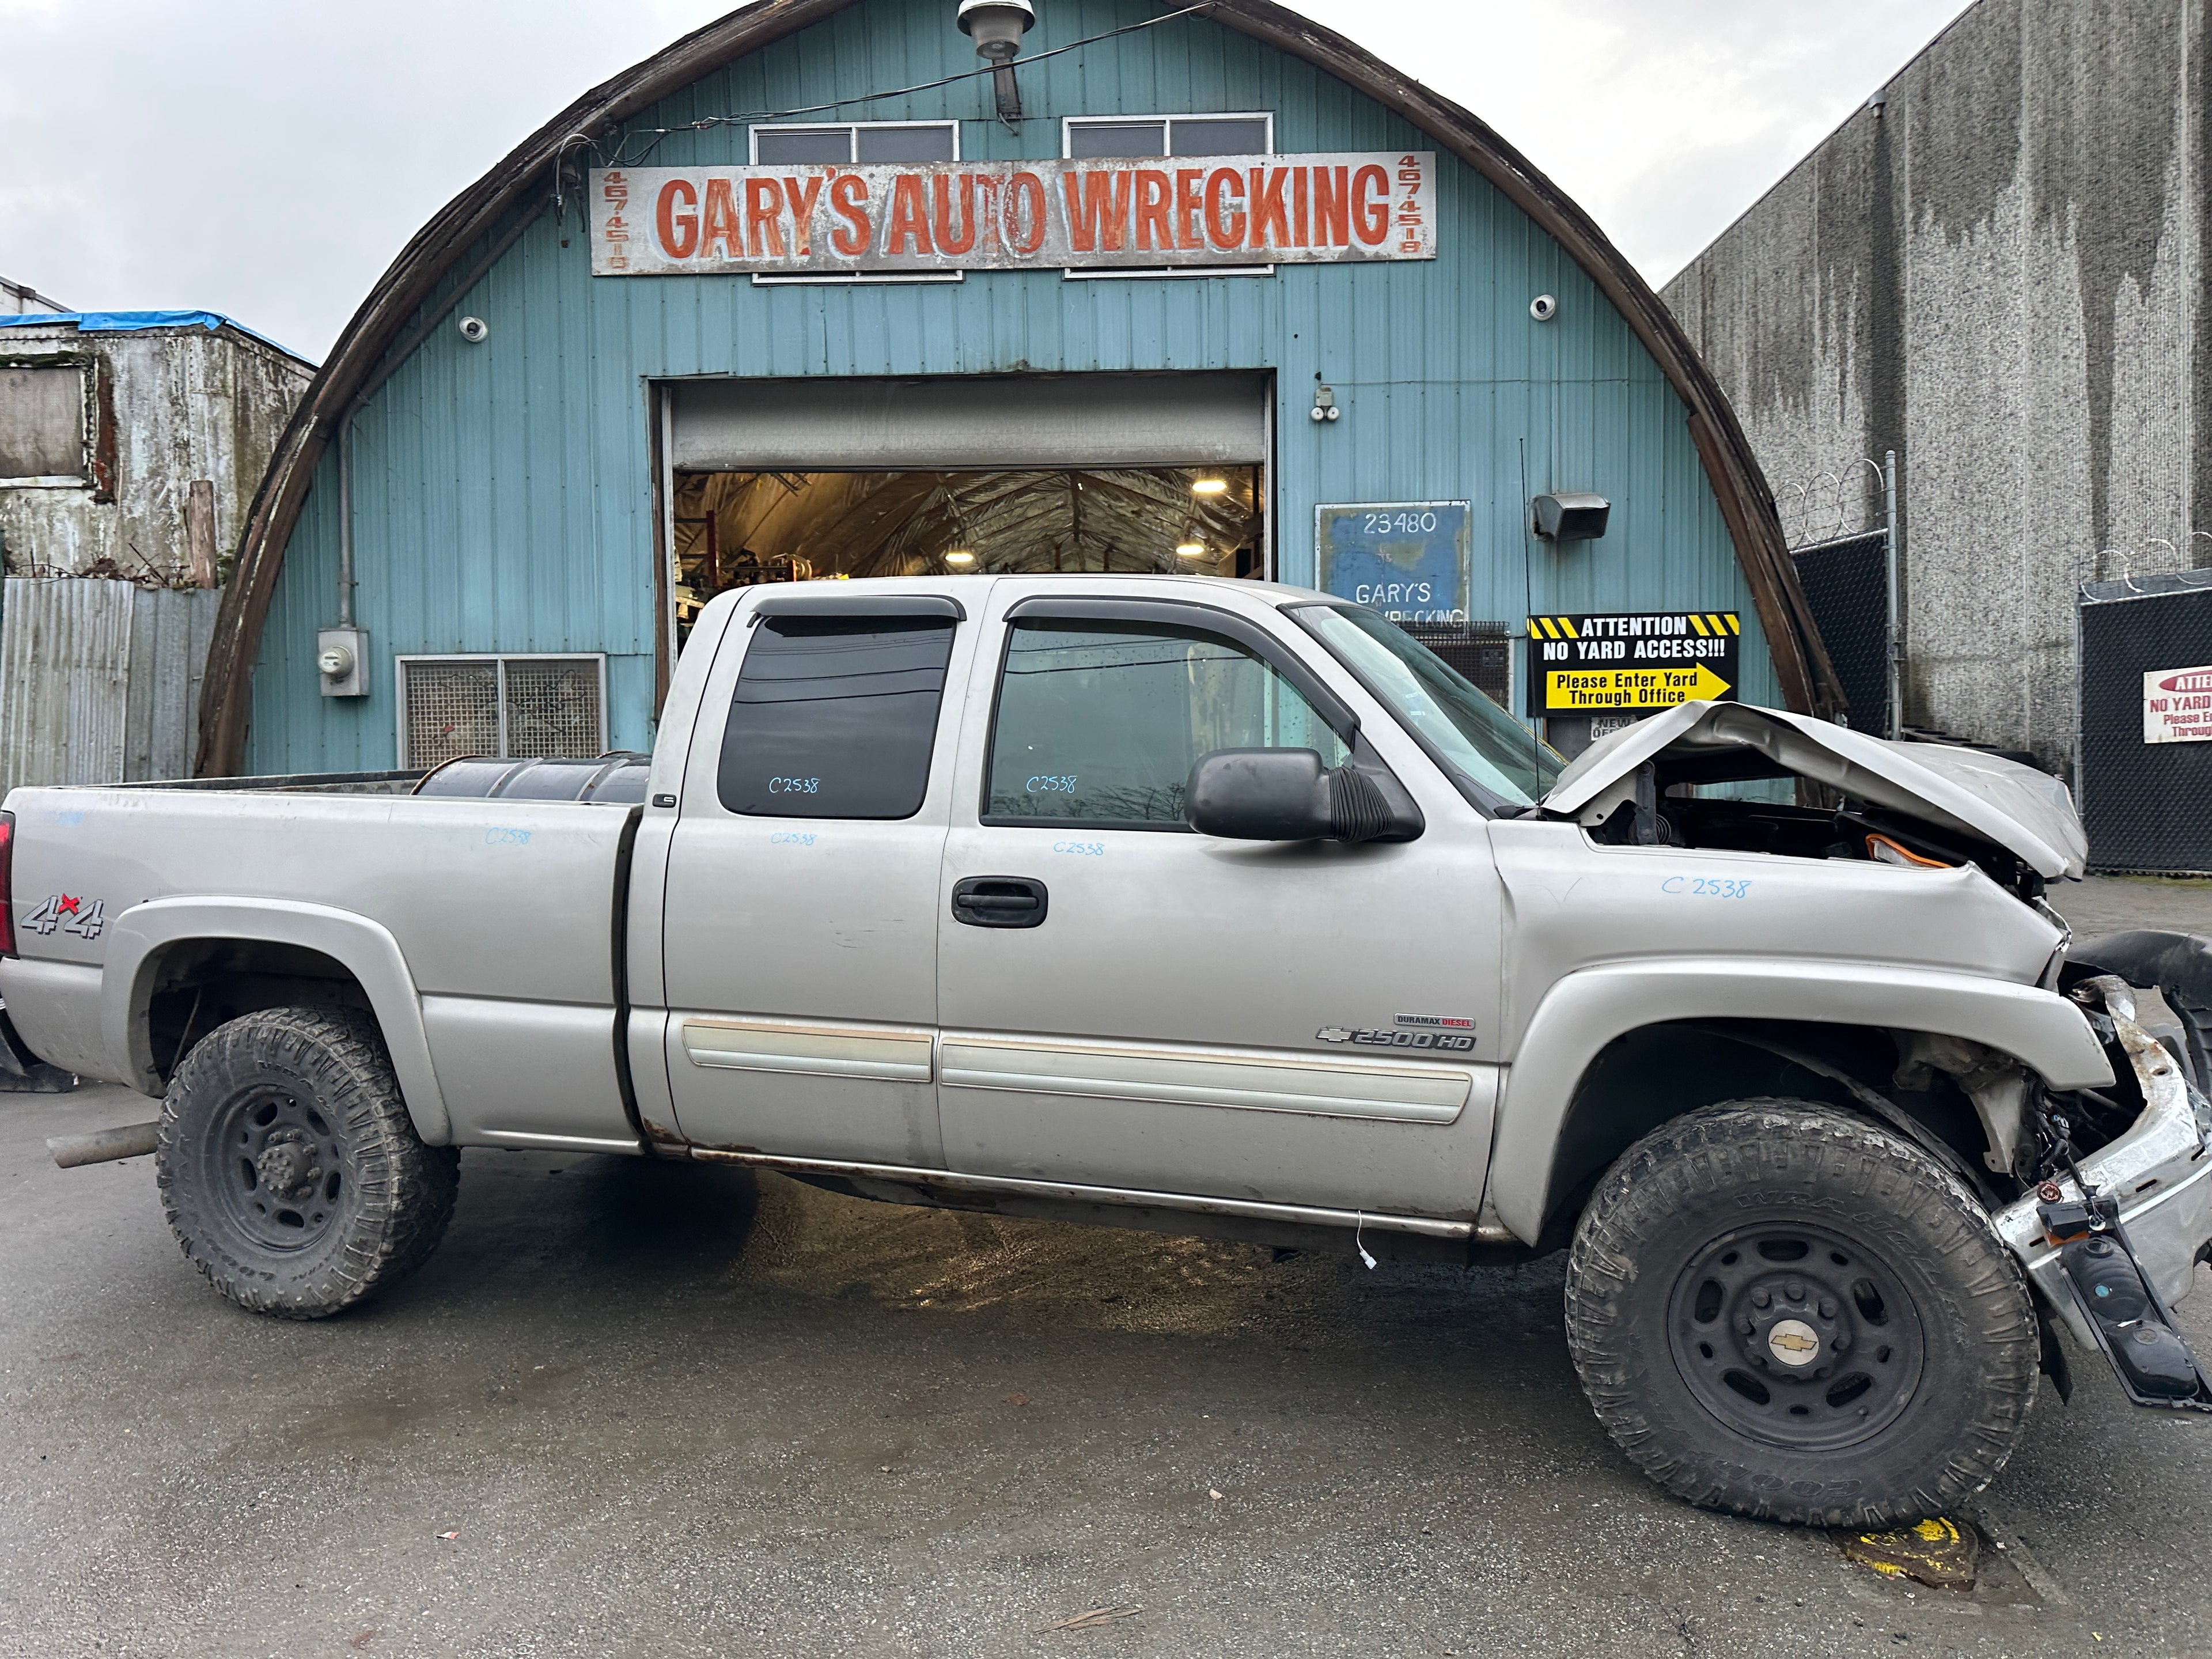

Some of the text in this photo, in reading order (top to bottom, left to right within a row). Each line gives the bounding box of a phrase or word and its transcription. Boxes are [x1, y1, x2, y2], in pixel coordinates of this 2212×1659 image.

[656, 164, 1390, 259] GARY'S AUTO WRECKING
[1363, 512, 1437, 534] 23480
[1355, 582, 1431, 604] GARY'S
[1581, 616, 1687, 638] ATTENTION
[1543, 638, 1726, 661] NO YARD ACCESS!!!
[1556, 671, 1698, 690] Please Enter Yard
[2175, 674, 2212, 691] ATTE
[1569, 688, 1685, 706] Through Office
[2150, 695, 2211, 713] NO YARD
[1599, 718, 1631, 728] NEW
[2163, 714, 2200, 725] Please
[2172, 725, 2212, 737] Throug
[768, 777, 821, 794] C2538
[1026, 775, 1078, 794] C2538
[1053, 841, 1105, 856] C2538
[1397, 1015, 1472, 1028] DURAMAX DIESEL
[1354, 1029, 1472, 1050] 2500 HD
